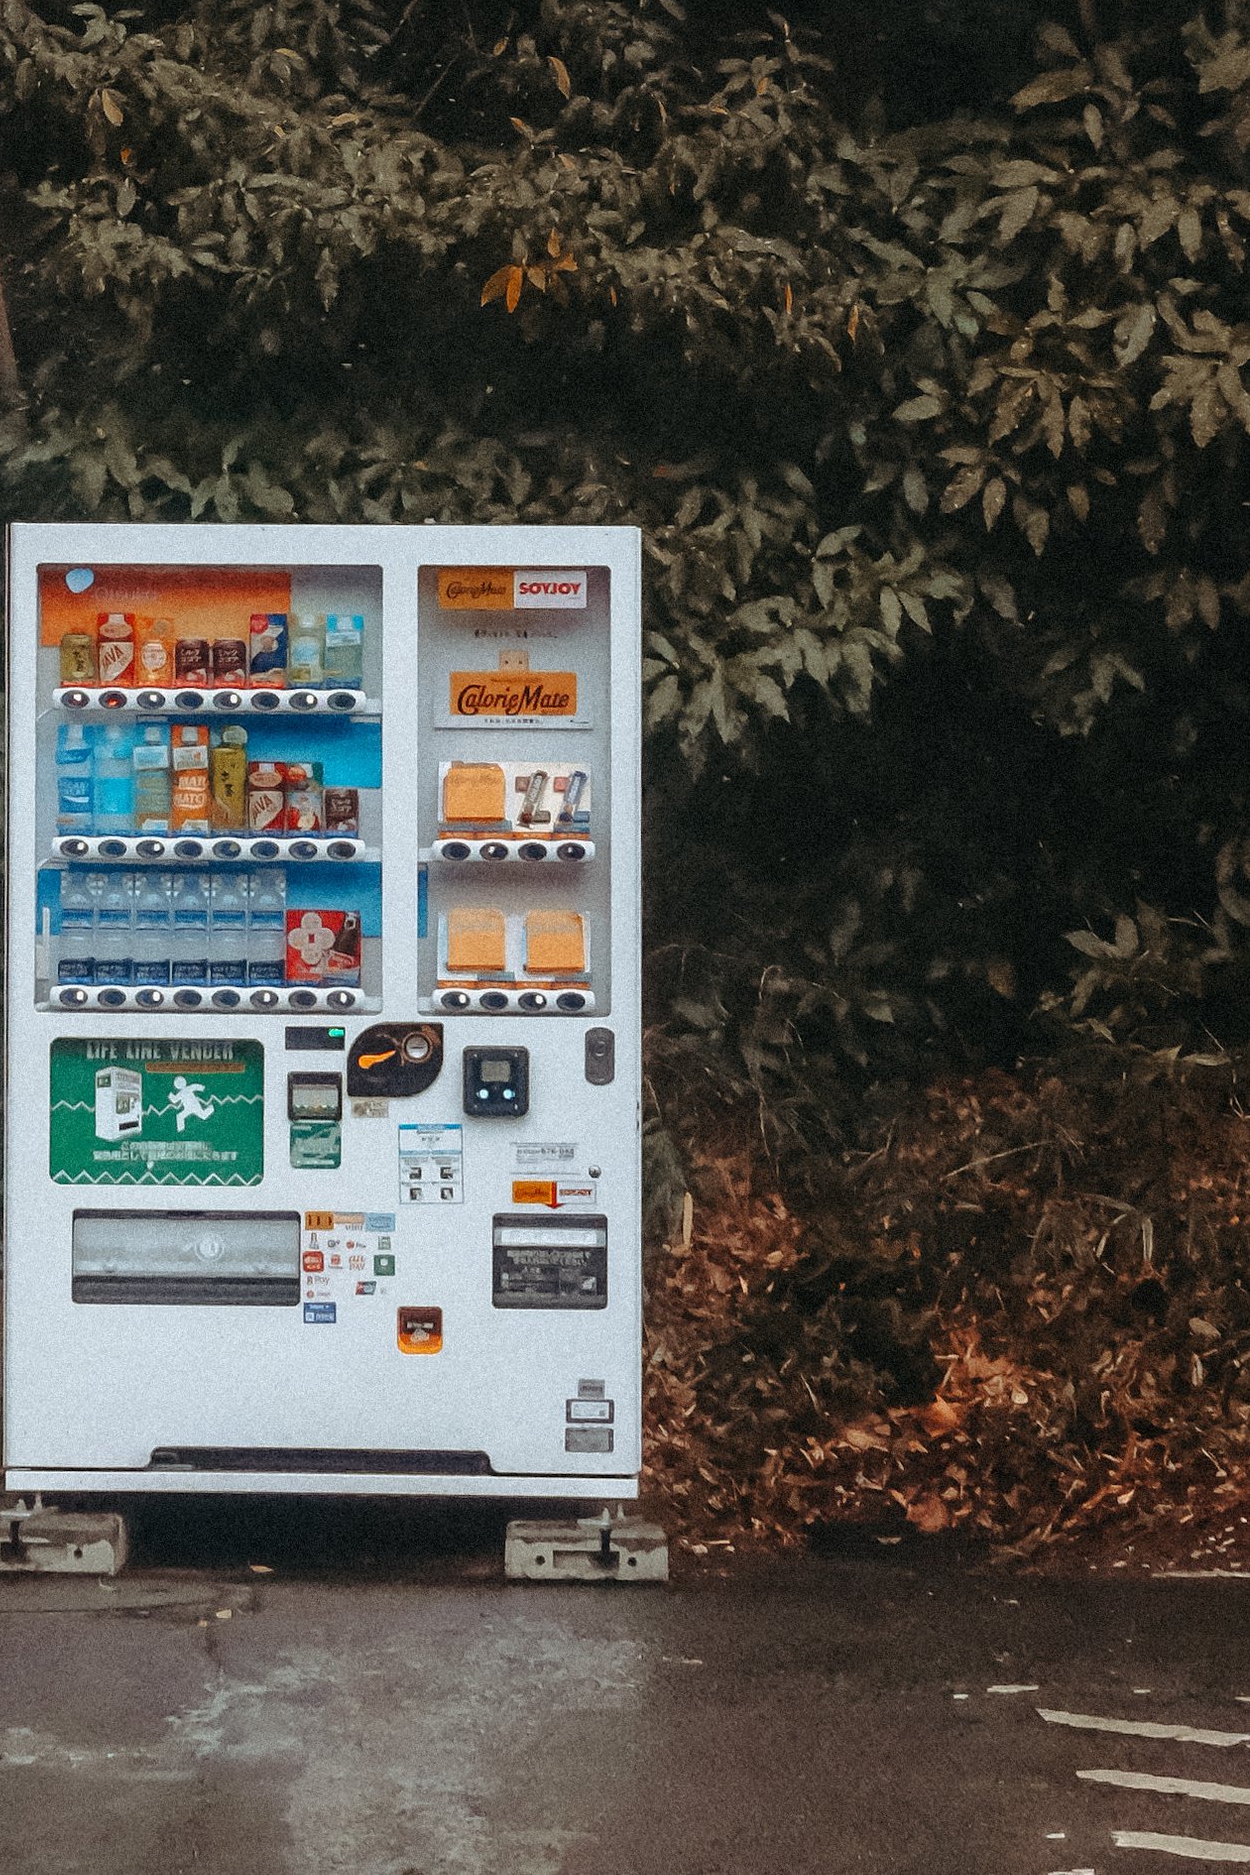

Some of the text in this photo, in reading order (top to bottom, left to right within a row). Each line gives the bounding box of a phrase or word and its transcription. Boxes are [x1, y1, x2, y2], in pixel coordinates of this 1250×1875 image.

[519, 582, 581, 595] SOYJOY
[457, 684, 570, 716] CalorieMate
[86, 1041, 234, 1060] LIFE LINE VENDER
